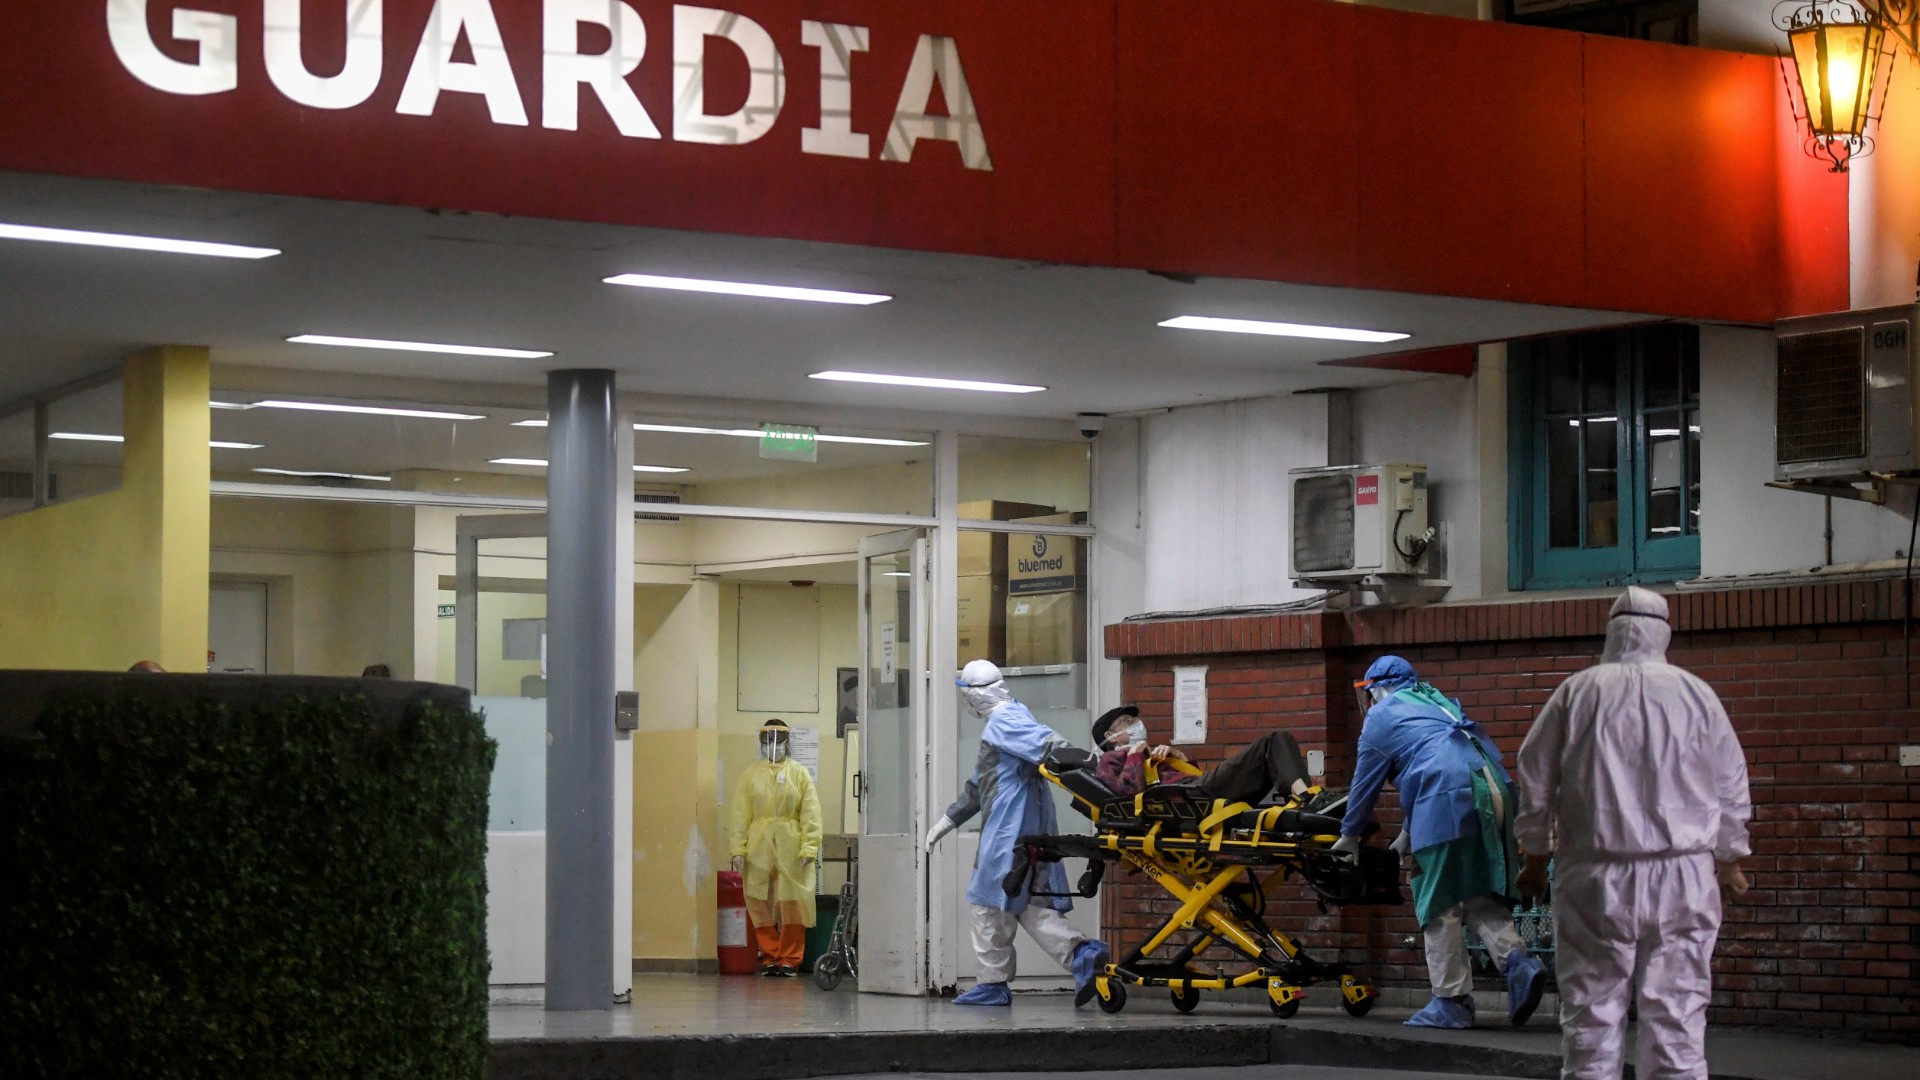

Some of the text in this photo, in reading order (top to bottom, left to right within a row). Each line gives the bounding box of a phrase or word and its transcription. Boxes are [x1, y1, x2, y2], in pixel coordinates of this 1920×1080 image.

[106, 0, 994, 171] GUARDIA
[1874, 329, 1905, 348] BGH
[1358, 486, 1376, 495] SANYO
[1018, 555, 1062, 573] bluemed
[438, 606, 454, 616] ALIDA
[1126, 850, 1162, 879] stryker
